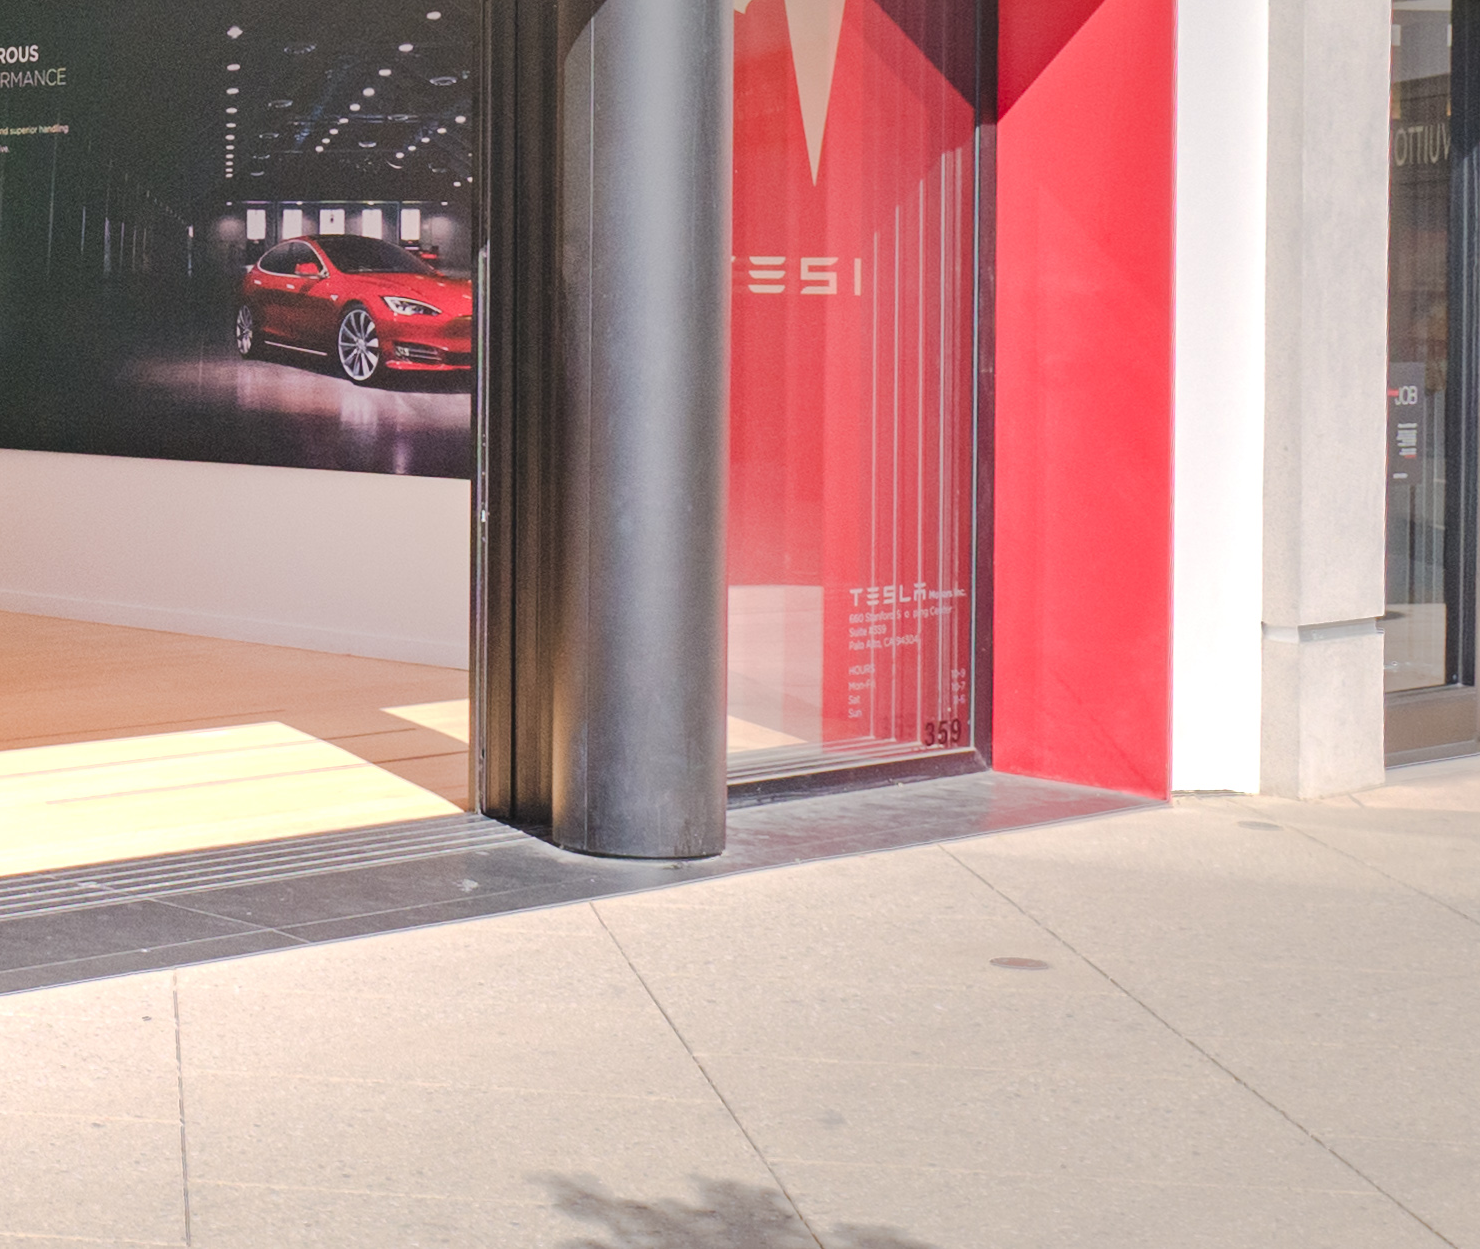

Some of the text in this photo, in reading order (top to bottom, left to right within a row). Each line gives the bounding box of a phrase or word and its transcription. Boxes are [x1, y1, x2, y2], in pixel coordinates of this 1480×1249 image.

[10, 125, 38, 137] superior
[39, 124, 70, 135] handling
[849, 583, 926, 607] TESLA
[848, 708, 862, 719] Sun
[925, 718, 961, 746] 359
